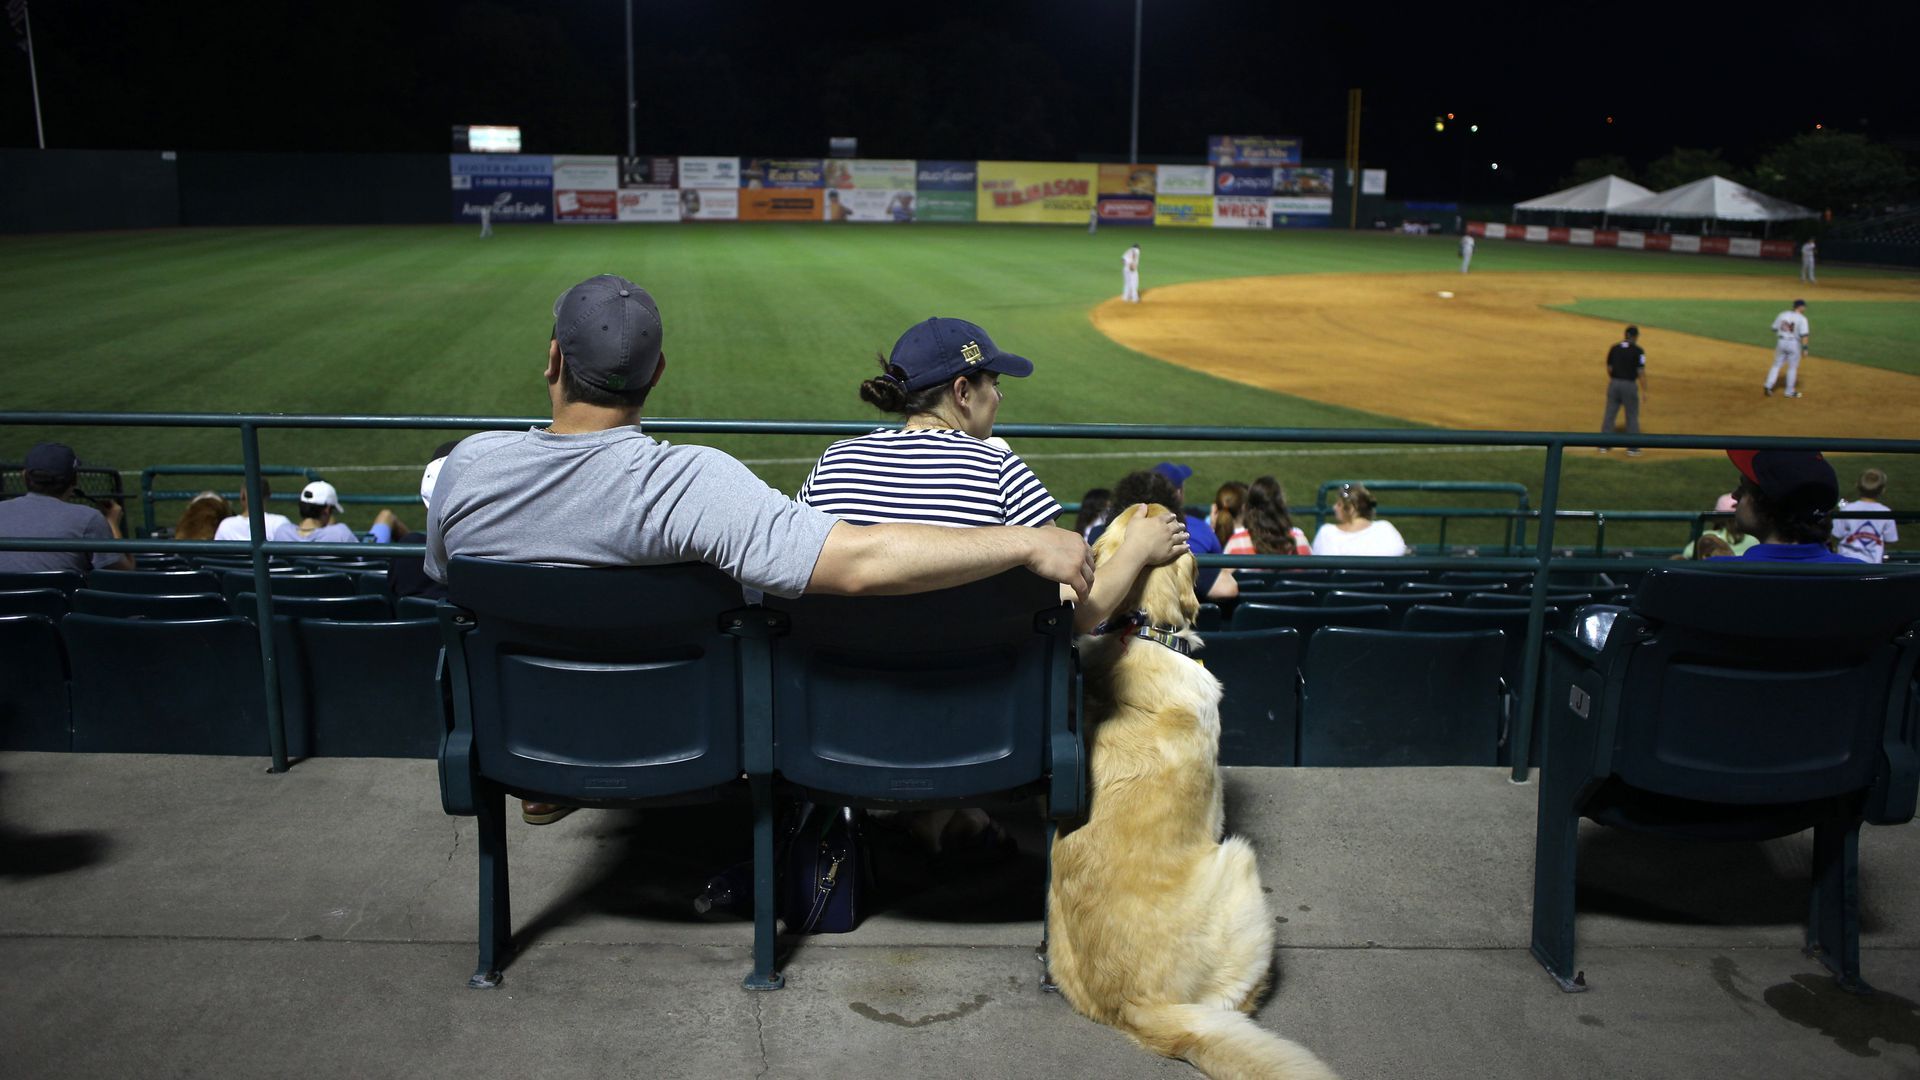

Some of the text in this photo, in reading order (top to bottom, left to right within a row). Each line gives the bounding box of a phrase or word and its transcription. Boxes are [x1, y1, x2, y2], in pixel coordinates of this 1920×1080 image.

[516, 202, 546, 217] Eagle
[1218, 204, 1266, 217] WRECK
[1575, 693, 1584, 710] J
